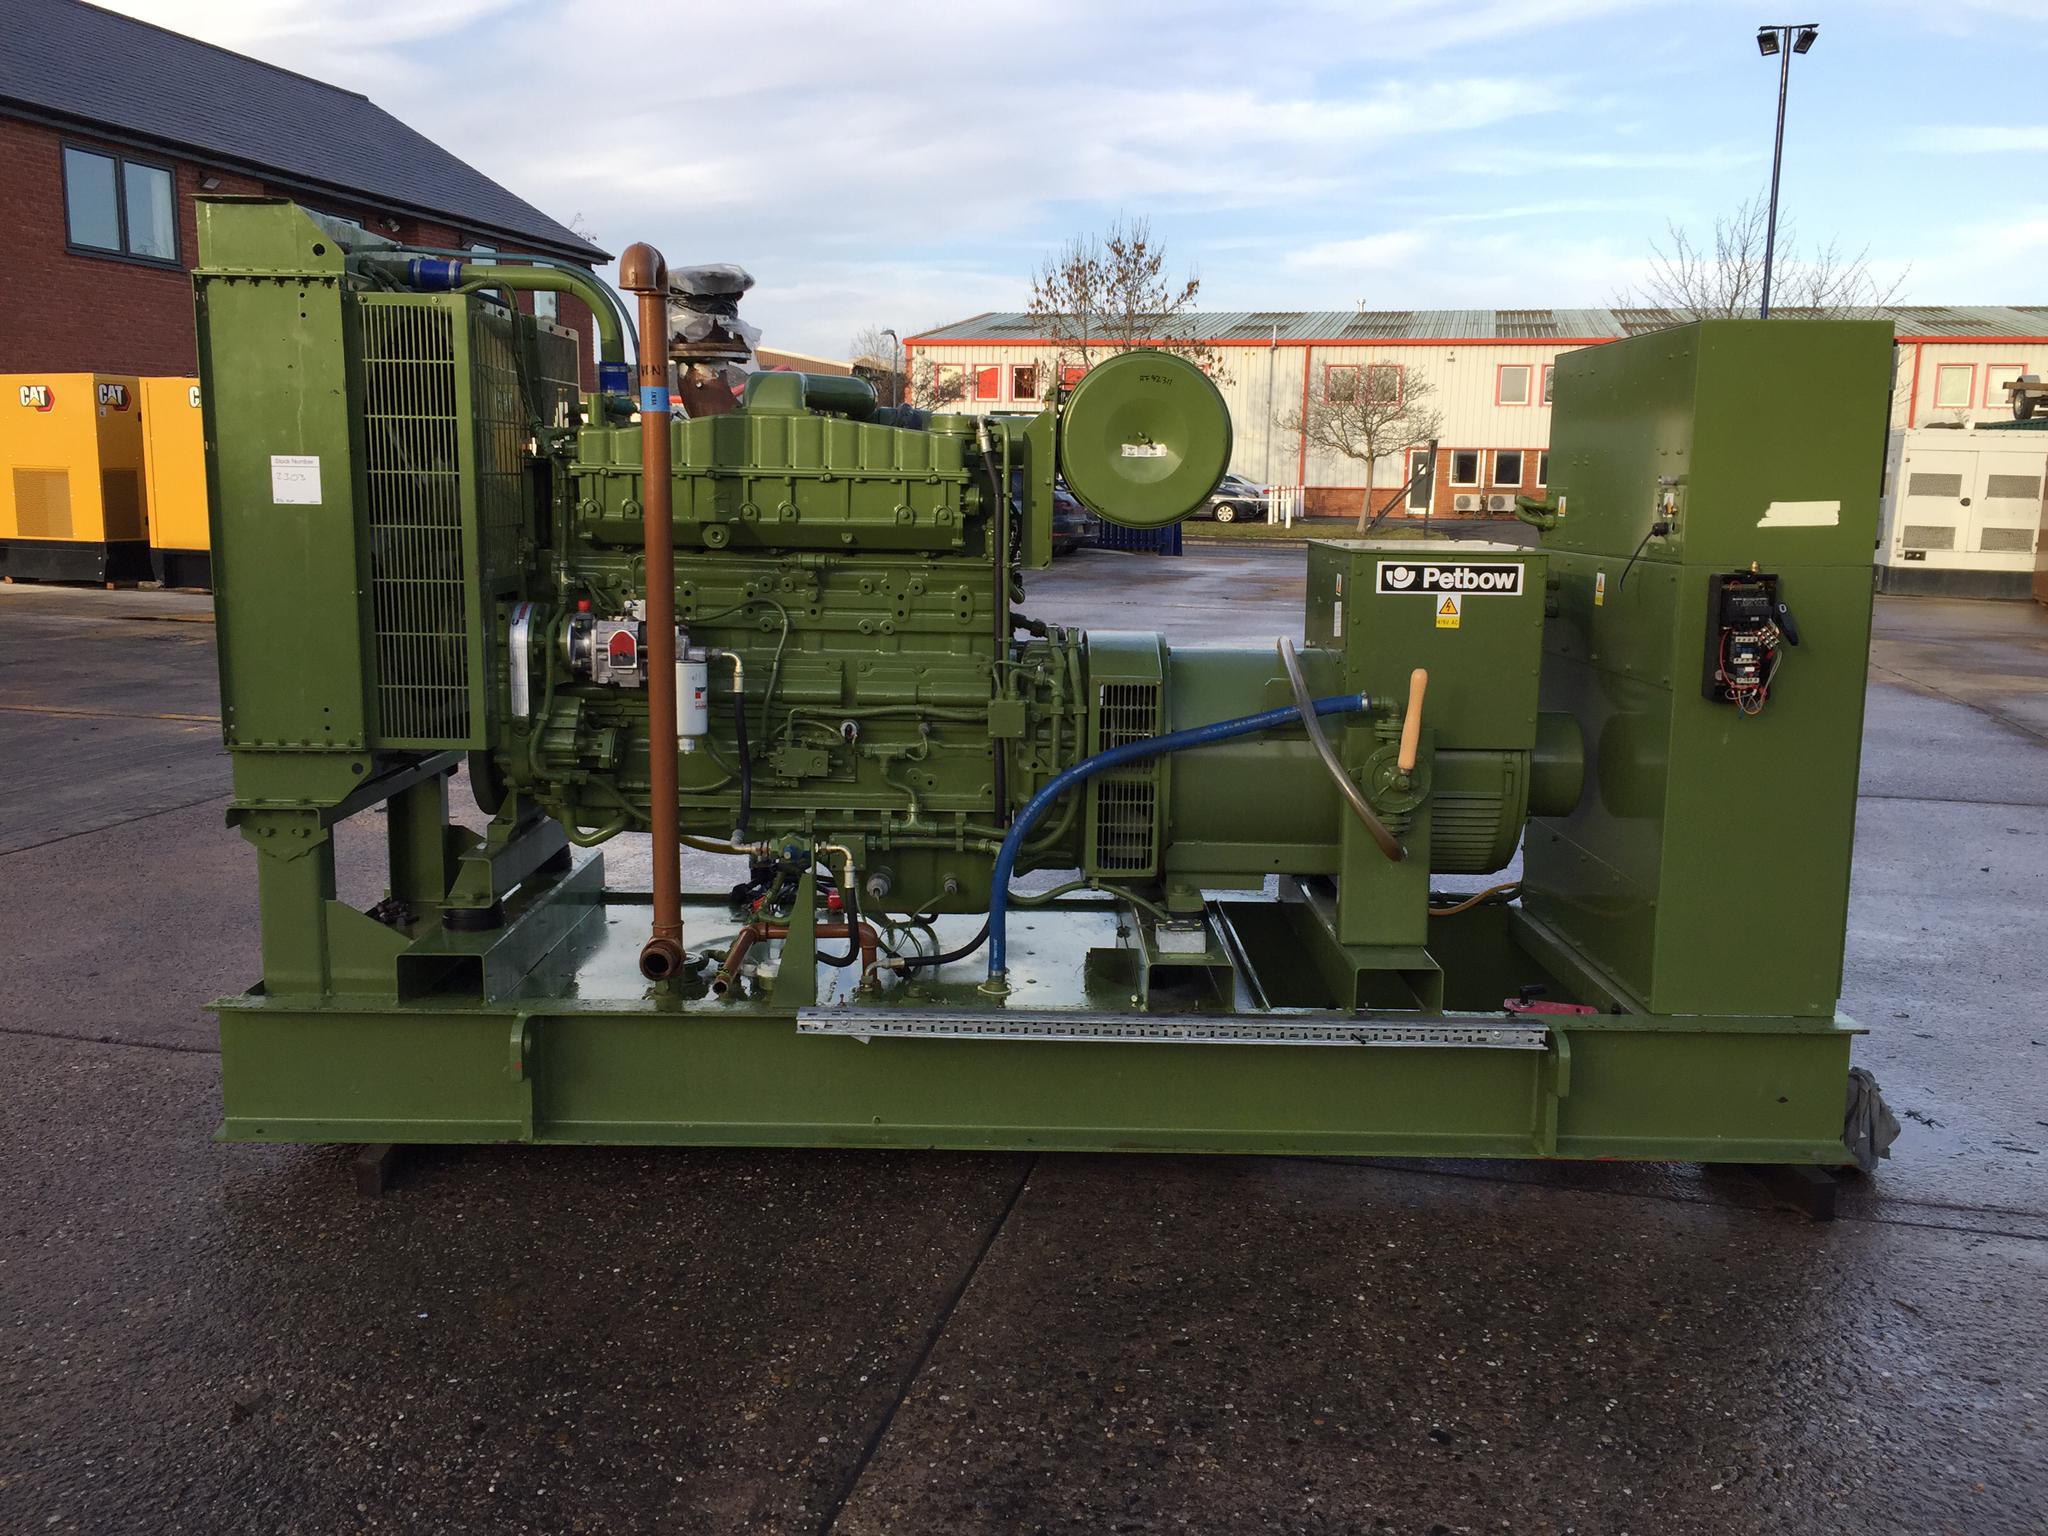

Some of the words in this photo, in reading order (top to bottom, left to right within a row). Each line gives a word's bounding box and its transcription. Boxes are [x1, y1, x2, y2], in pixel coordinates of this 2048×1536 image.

[20, 385, 46, 407] CAT
[98, 384, 123, 405] CAT
[1423, 567, 1516, 590] Petbow
